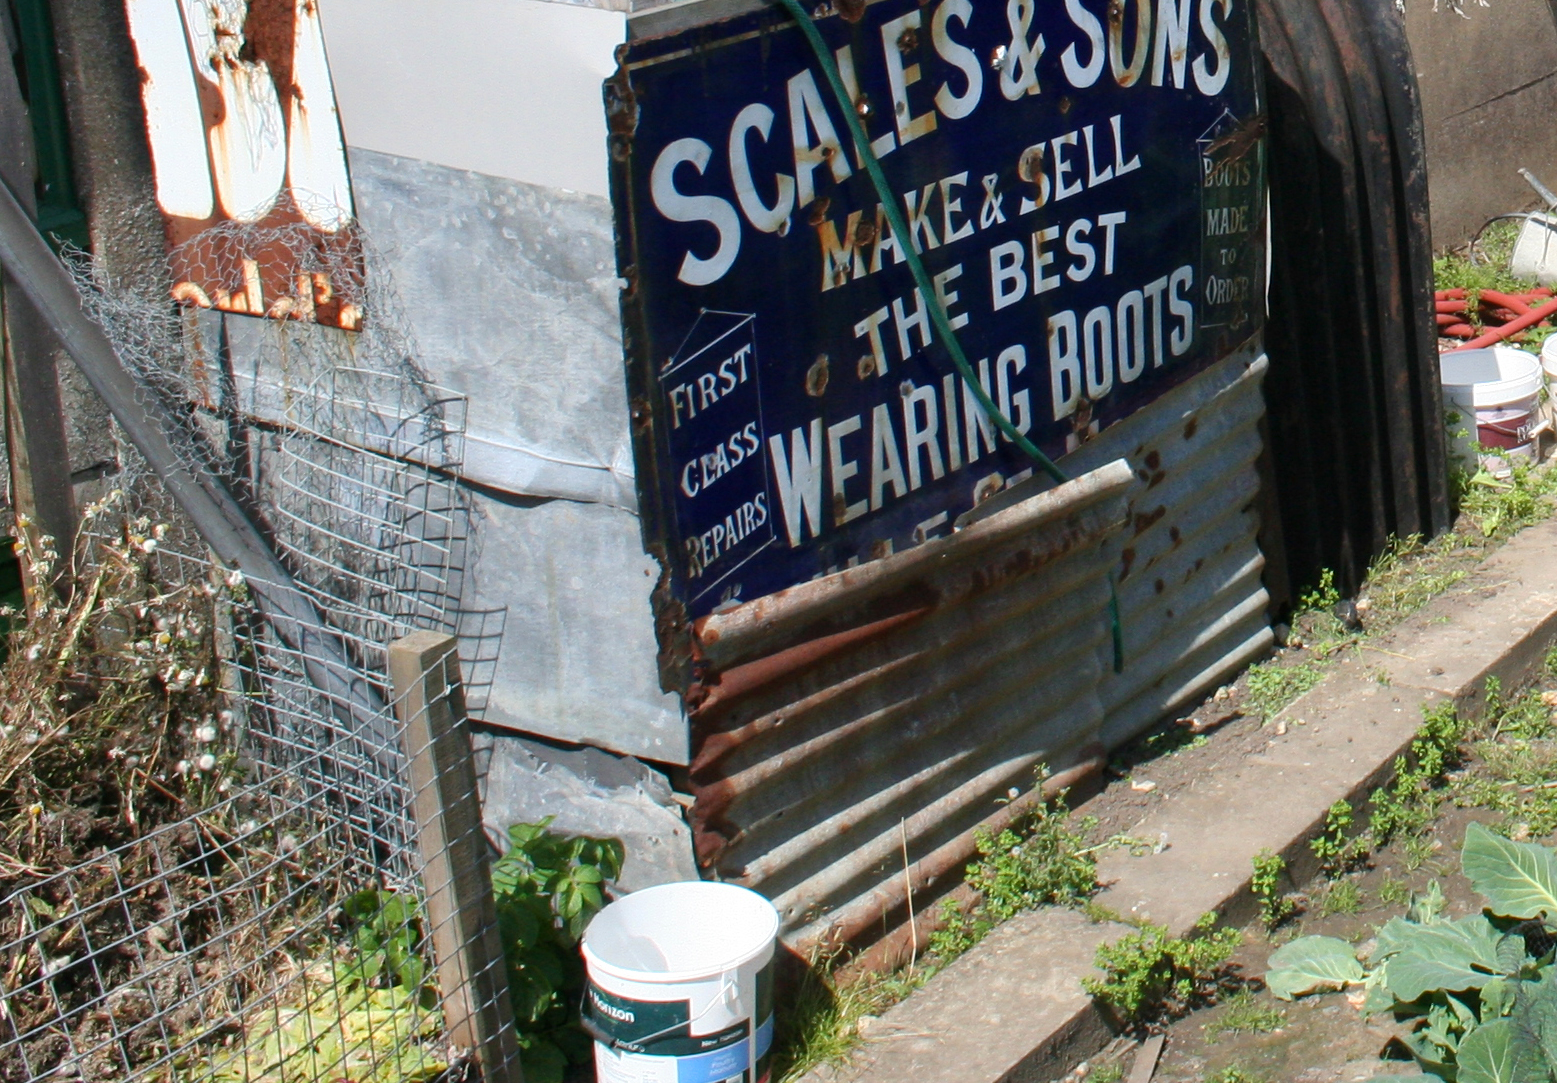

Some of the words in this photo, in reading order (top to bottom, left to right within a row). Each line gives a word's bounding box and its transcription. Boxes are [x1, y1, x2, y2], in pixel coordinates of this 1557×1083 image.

[816, 170, 976, 293] MAKE
[979, 173, 1007, 230] &
[1018, 113, 1143, 216] SELL
[1203, 156, 1251, 189] BOOTS
[1205, 205, 1249, 237] MADE
[1219, 248, 1237, 266] TO
[853, 262, 970, 378] THE
[988, 210, 1127, 312] BEST
[1205, 274, 1249, 306] ORDER
[667, 342, 752, 430] FIRST
[768, 344, 1032, 550] WEARING
[1047, 264, 1193, 422] BOOTS
[680, 420, 761, 499] CLASS
[685, 490, 768, 579] REPAIRS
